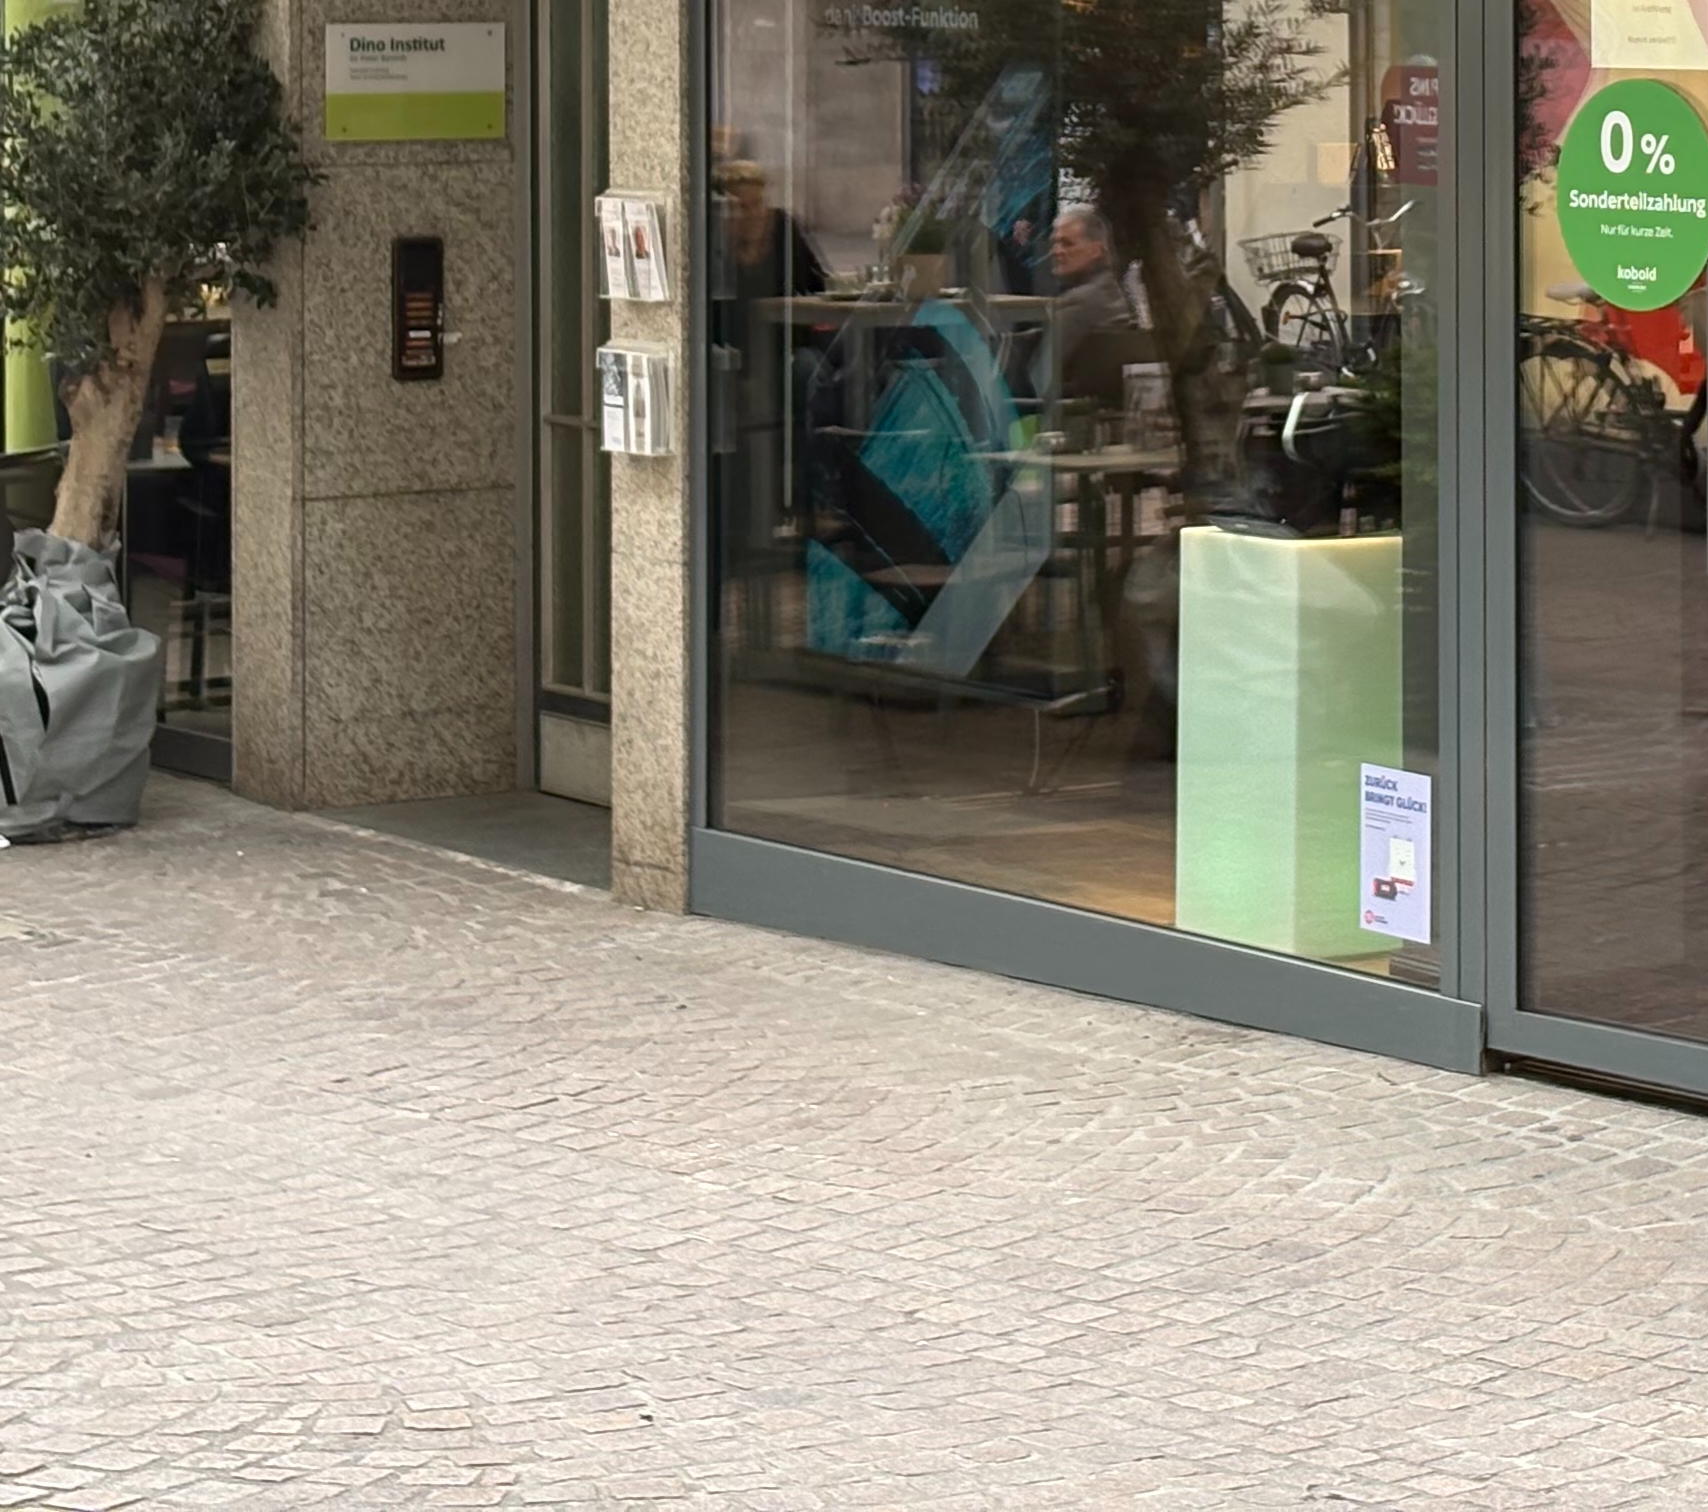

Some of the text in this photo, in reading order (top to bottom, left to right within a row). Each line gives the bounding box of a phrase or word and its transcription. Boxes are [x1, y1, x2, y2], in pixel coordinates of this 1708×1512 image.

[862, 5, 979, 29] Boost-Funktion
[349, 37, 446, 52] Dino Institut
[1569, 190, 1707, 219] Sonderteilzahlung
[1601, 224, 1616, 236] Nur
[1617, 224, 1630, 236] für
[1631, 224, 1654, 238] kurze
[1617, 265, 1657, 281] kobold
